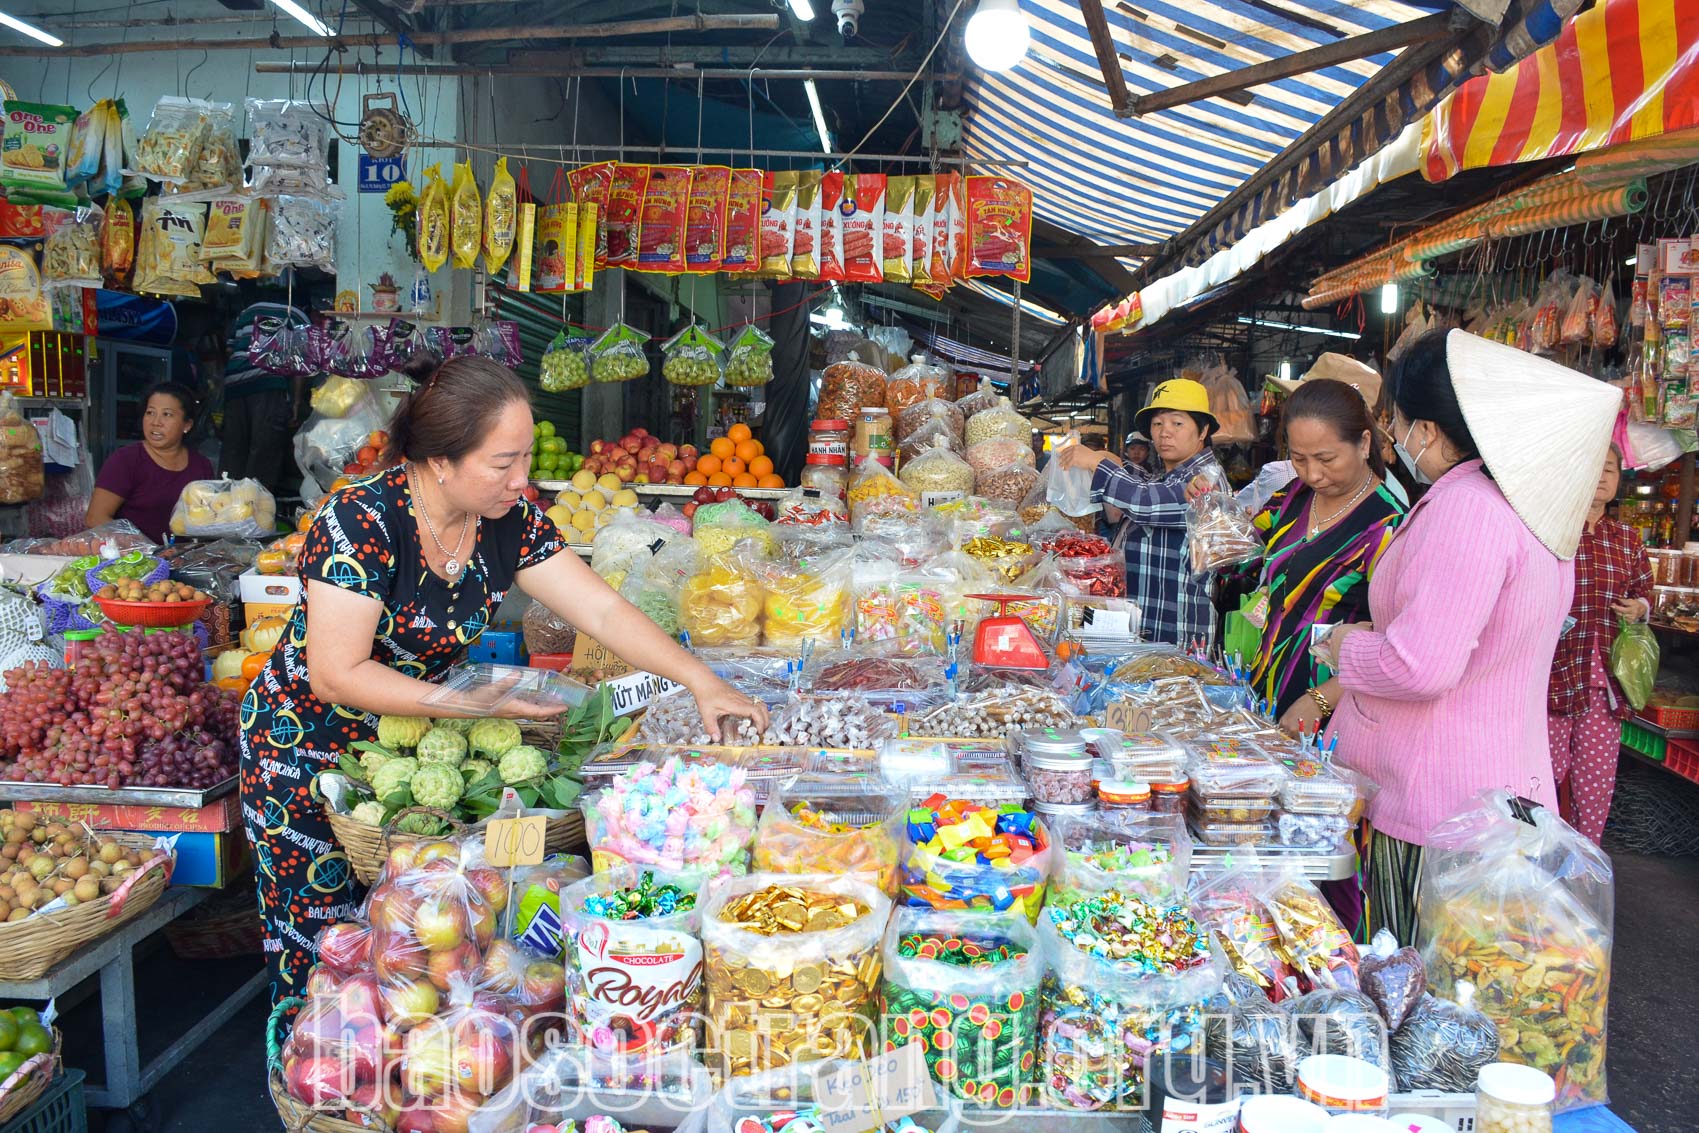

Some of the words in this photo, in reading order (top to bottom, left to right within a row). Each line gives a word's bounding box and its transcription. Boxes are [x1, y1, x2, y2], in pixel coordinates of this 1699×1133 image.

[10, 111, 43, 124] One
[23, 121, 56, 134] One
[364, 164, 400, 182] 10
[0, 260, 25, 269] nisa
[282, 827, 333, 853] BALANCIAGA
[494, 822, 541, 858] 100
[623, 954, 674, 965] CHOCOLATE
[588, 960, 703, 1023] Royal
